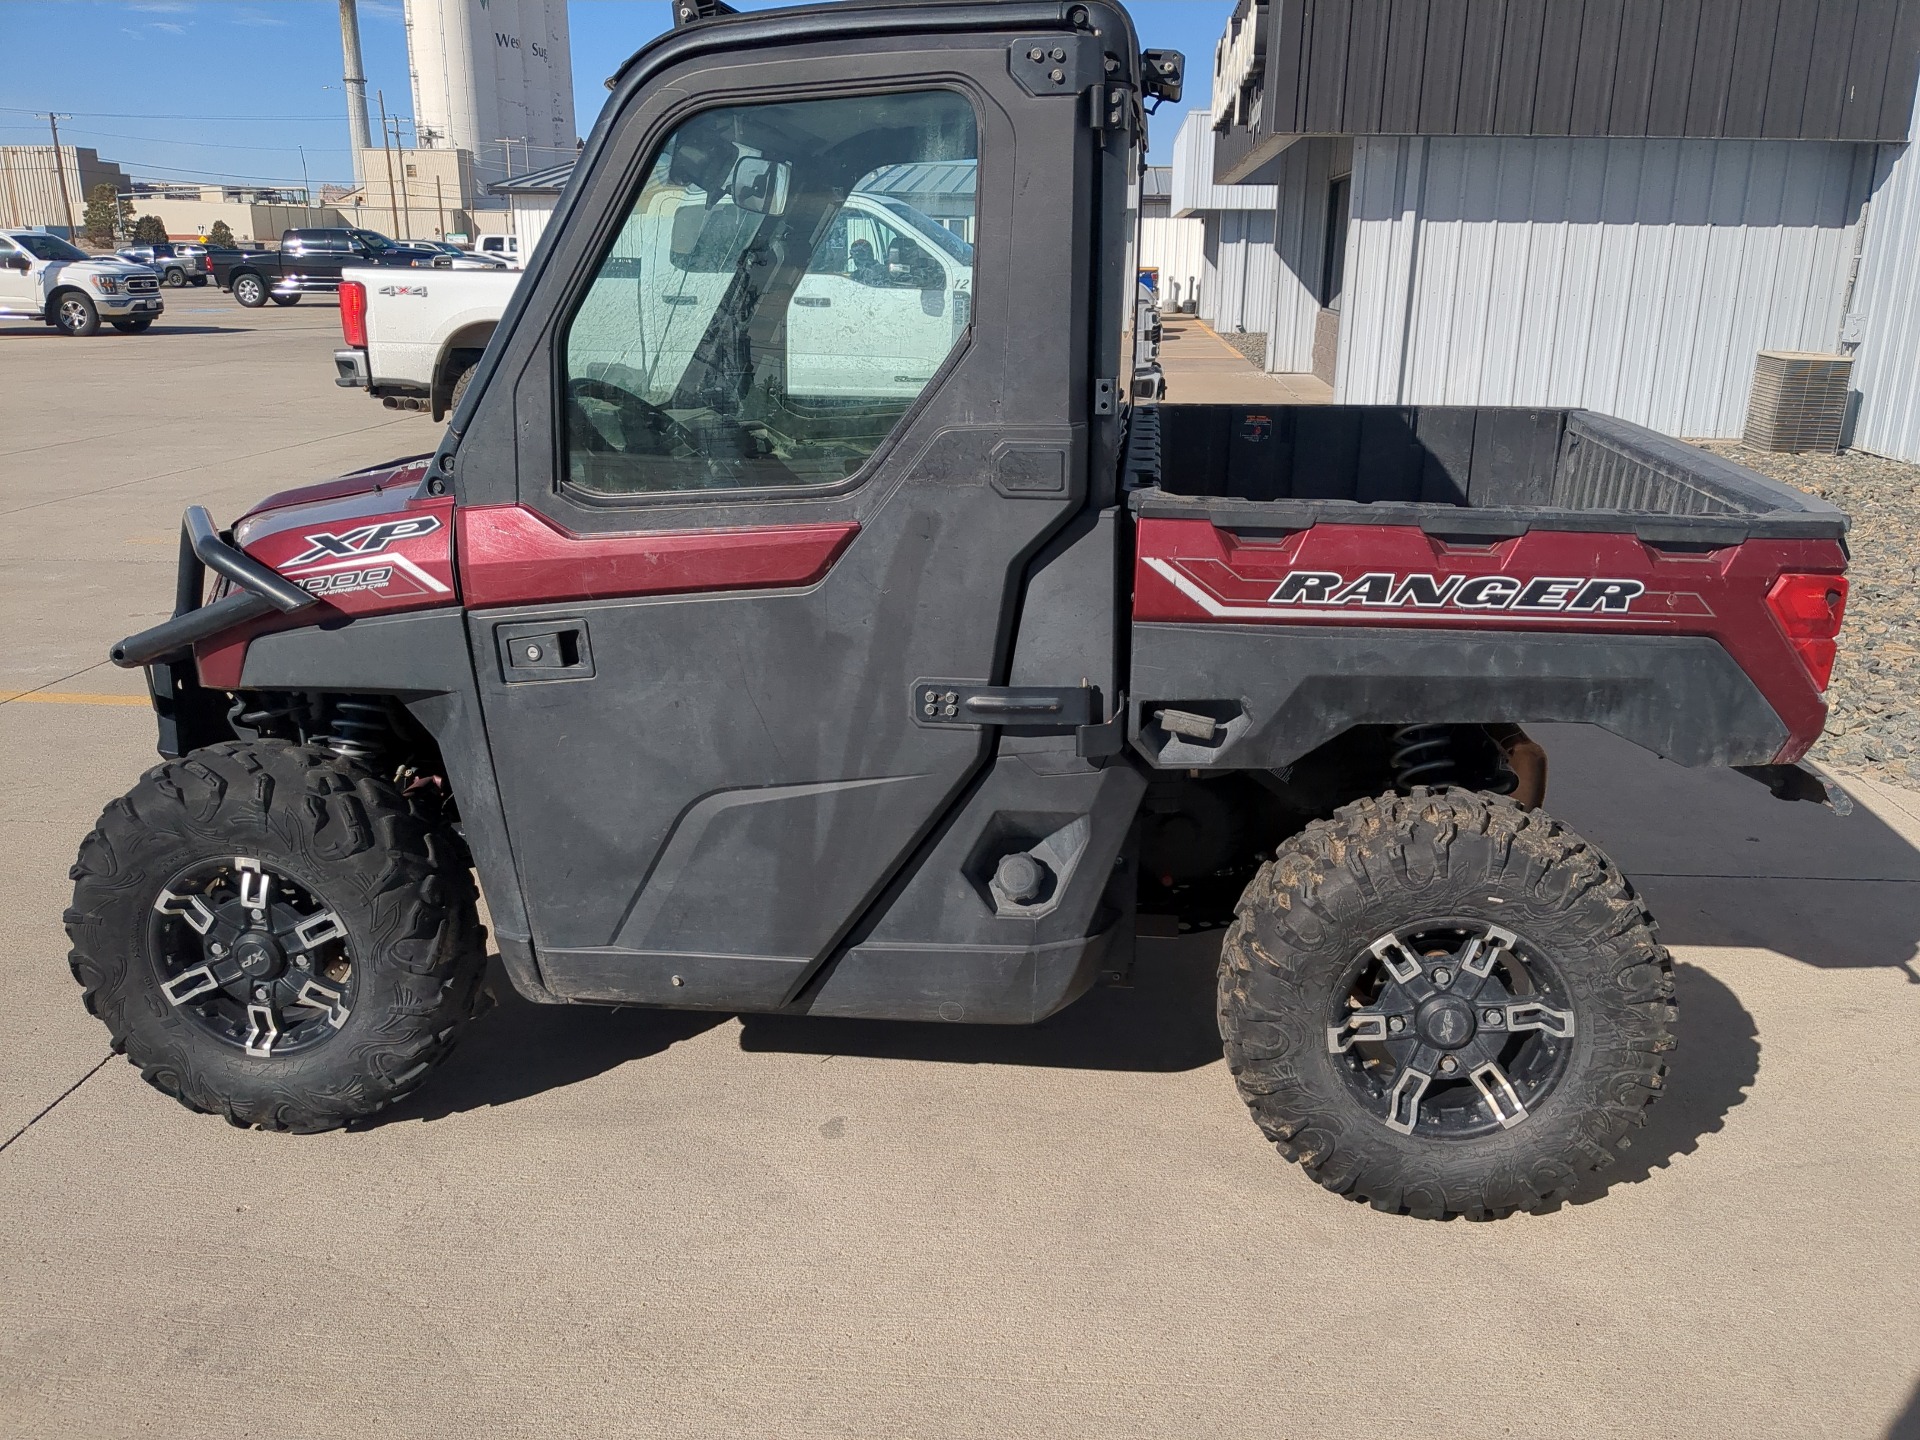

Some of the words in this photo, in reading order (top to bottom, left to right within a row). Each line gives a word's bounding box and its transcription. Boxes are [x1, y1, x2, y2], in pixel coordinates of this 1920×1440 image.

[955, 279, 969, 289] 12
[278, 515, 441, 569] XP
[317, 584, 367, 597] OVERHEAD
[1268, 571, 1645, 612] RANGER
[241, 949, 265, 968] XP
